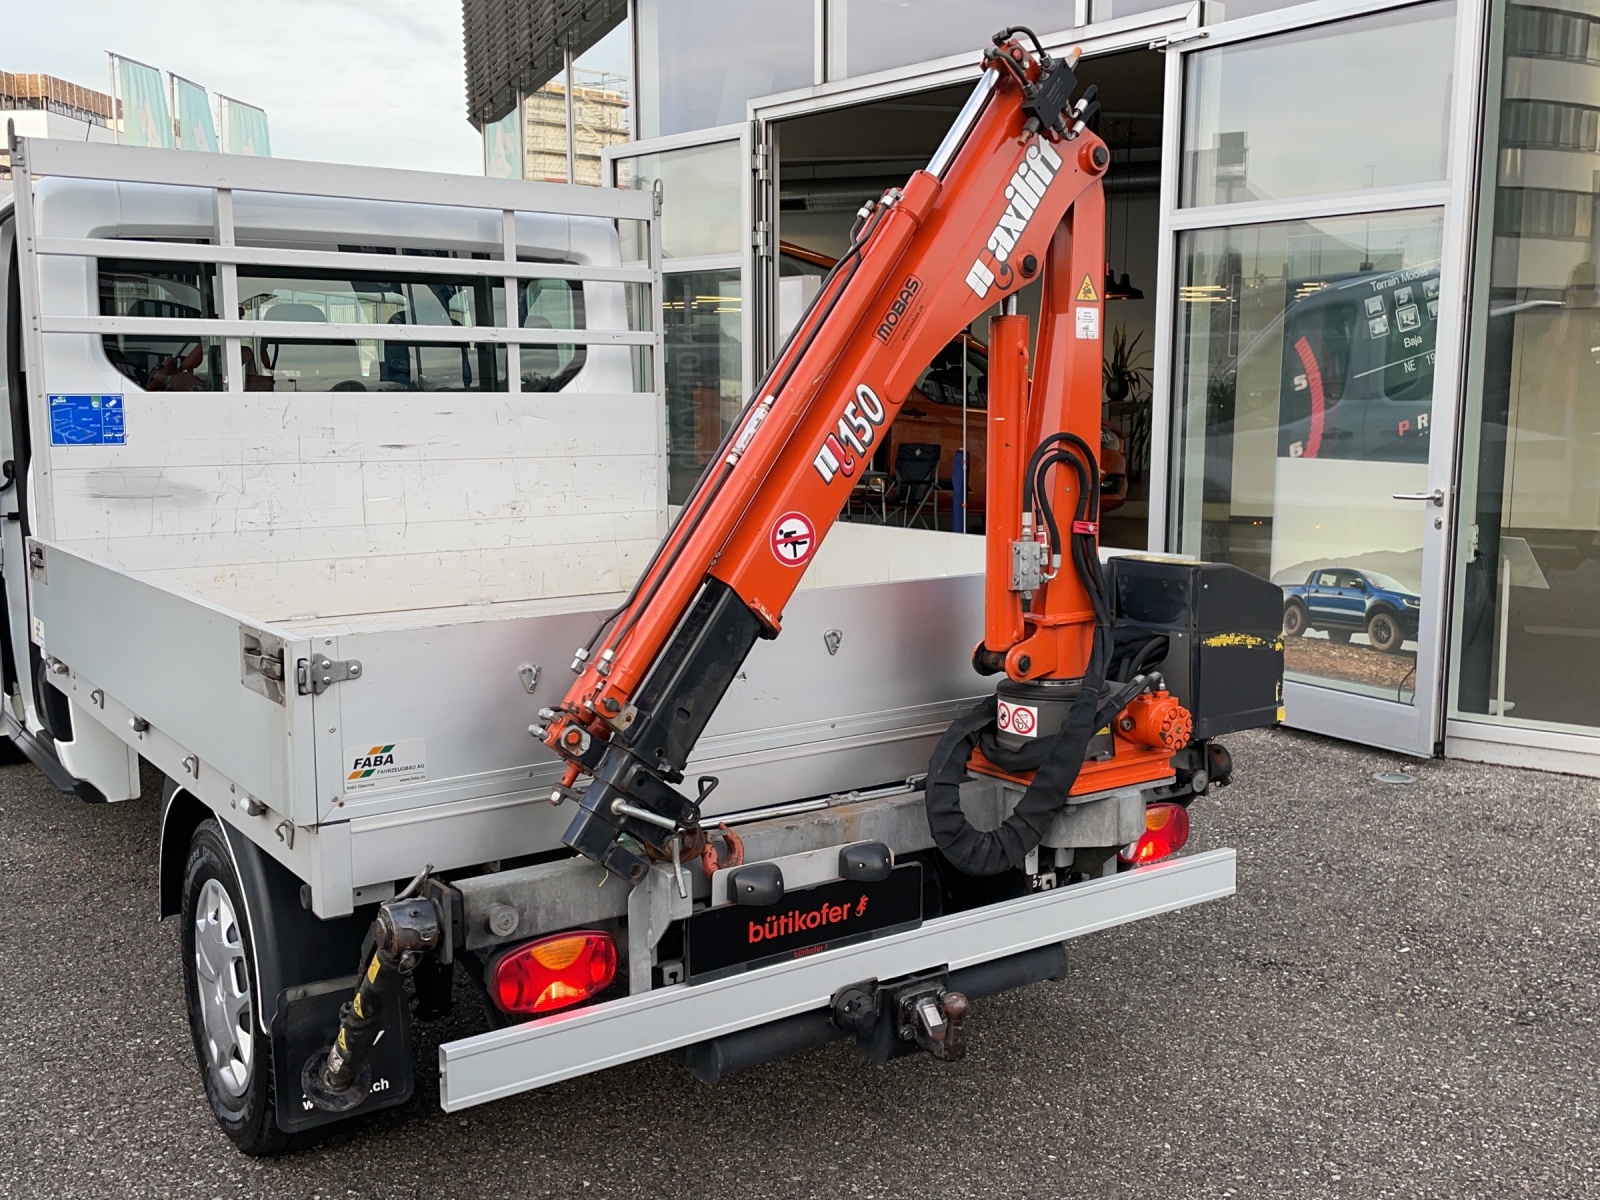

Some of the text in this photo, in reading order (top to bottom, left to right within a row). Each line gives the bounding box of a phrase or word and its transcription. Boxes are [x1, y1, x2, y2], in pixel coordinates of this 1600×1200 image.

[1370, 268, 1429, 292] Terrain Modes
[877, 277, 919, 342] MOBAS
[1403, 335, 1423, 349] Baja
[1403, 359, 1417, 374] NE
[1398, 413, 1428, 436] P R
[353, 754, 394, 769] FABA
[377, 764, 416, 774] FAHRZEUGBAU
[748, 902, 851, 943] bütikofer
